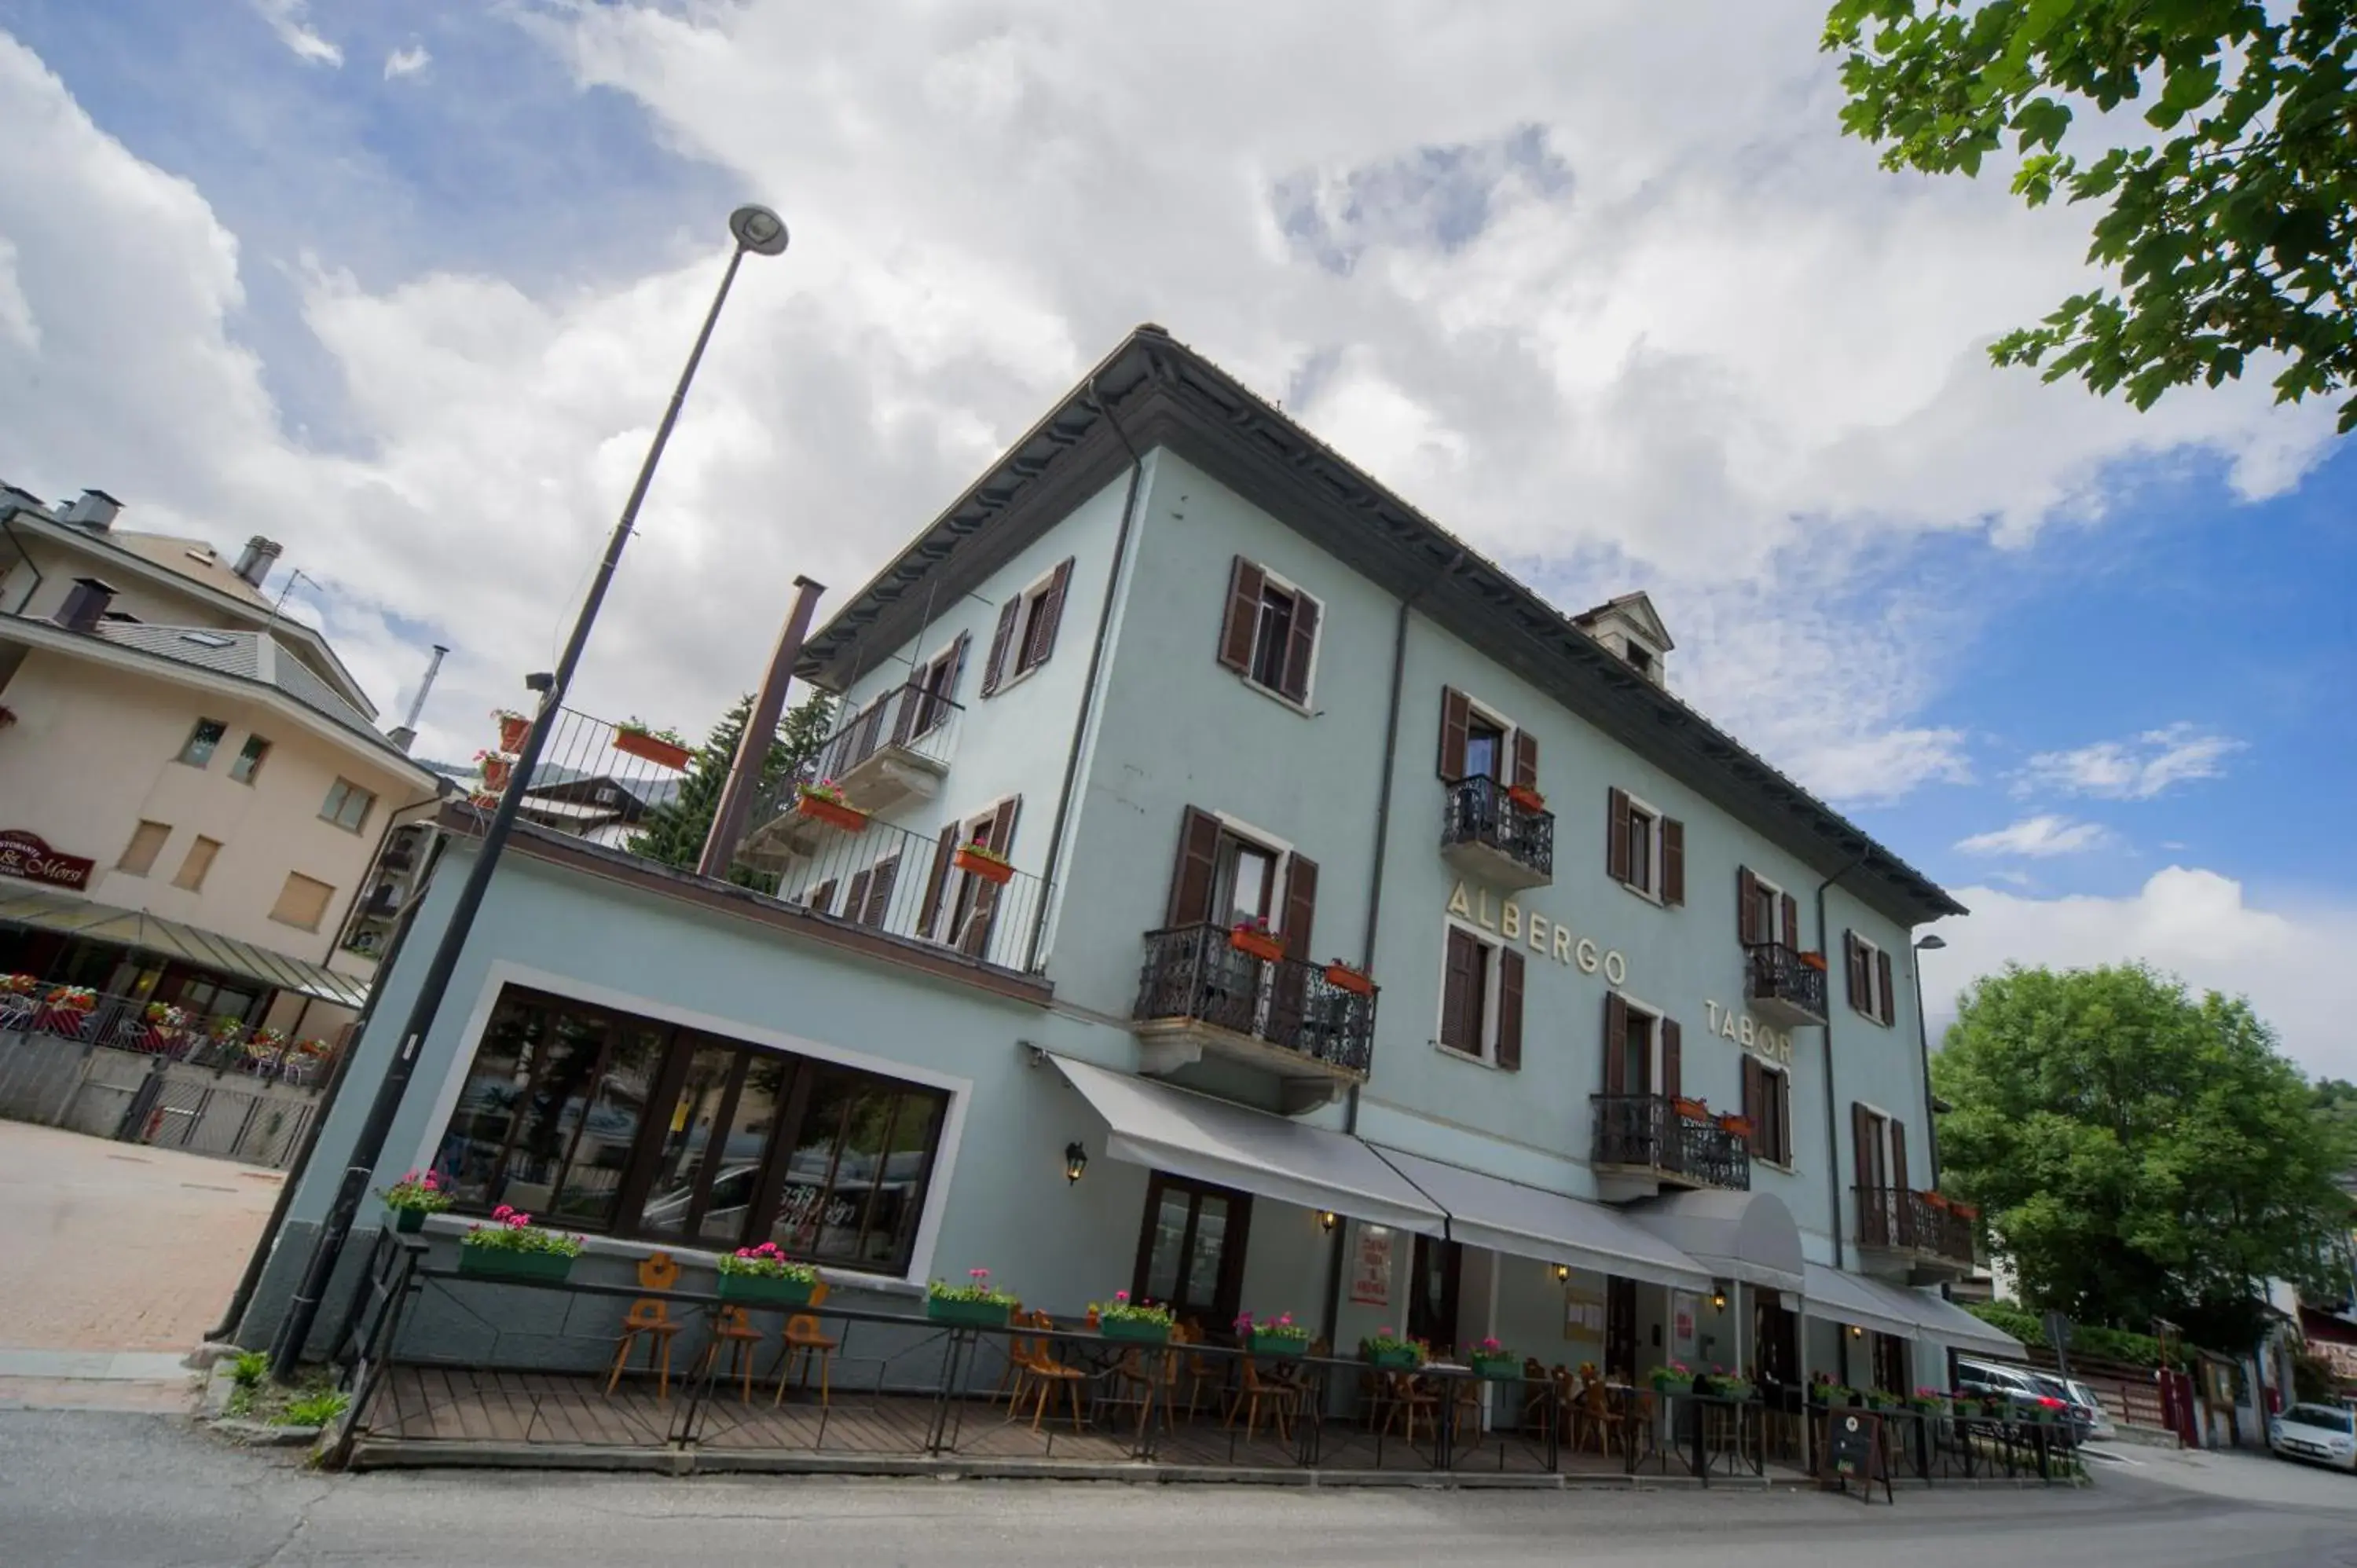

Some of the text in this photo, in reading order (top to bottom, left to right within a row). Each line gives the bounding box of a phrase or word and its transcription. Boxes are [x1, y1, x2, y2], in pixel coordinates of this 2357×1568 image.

[26, 858, 85, 882] Morsi
[1446, 881, 1791, 1068] ALBERGO TABOR
